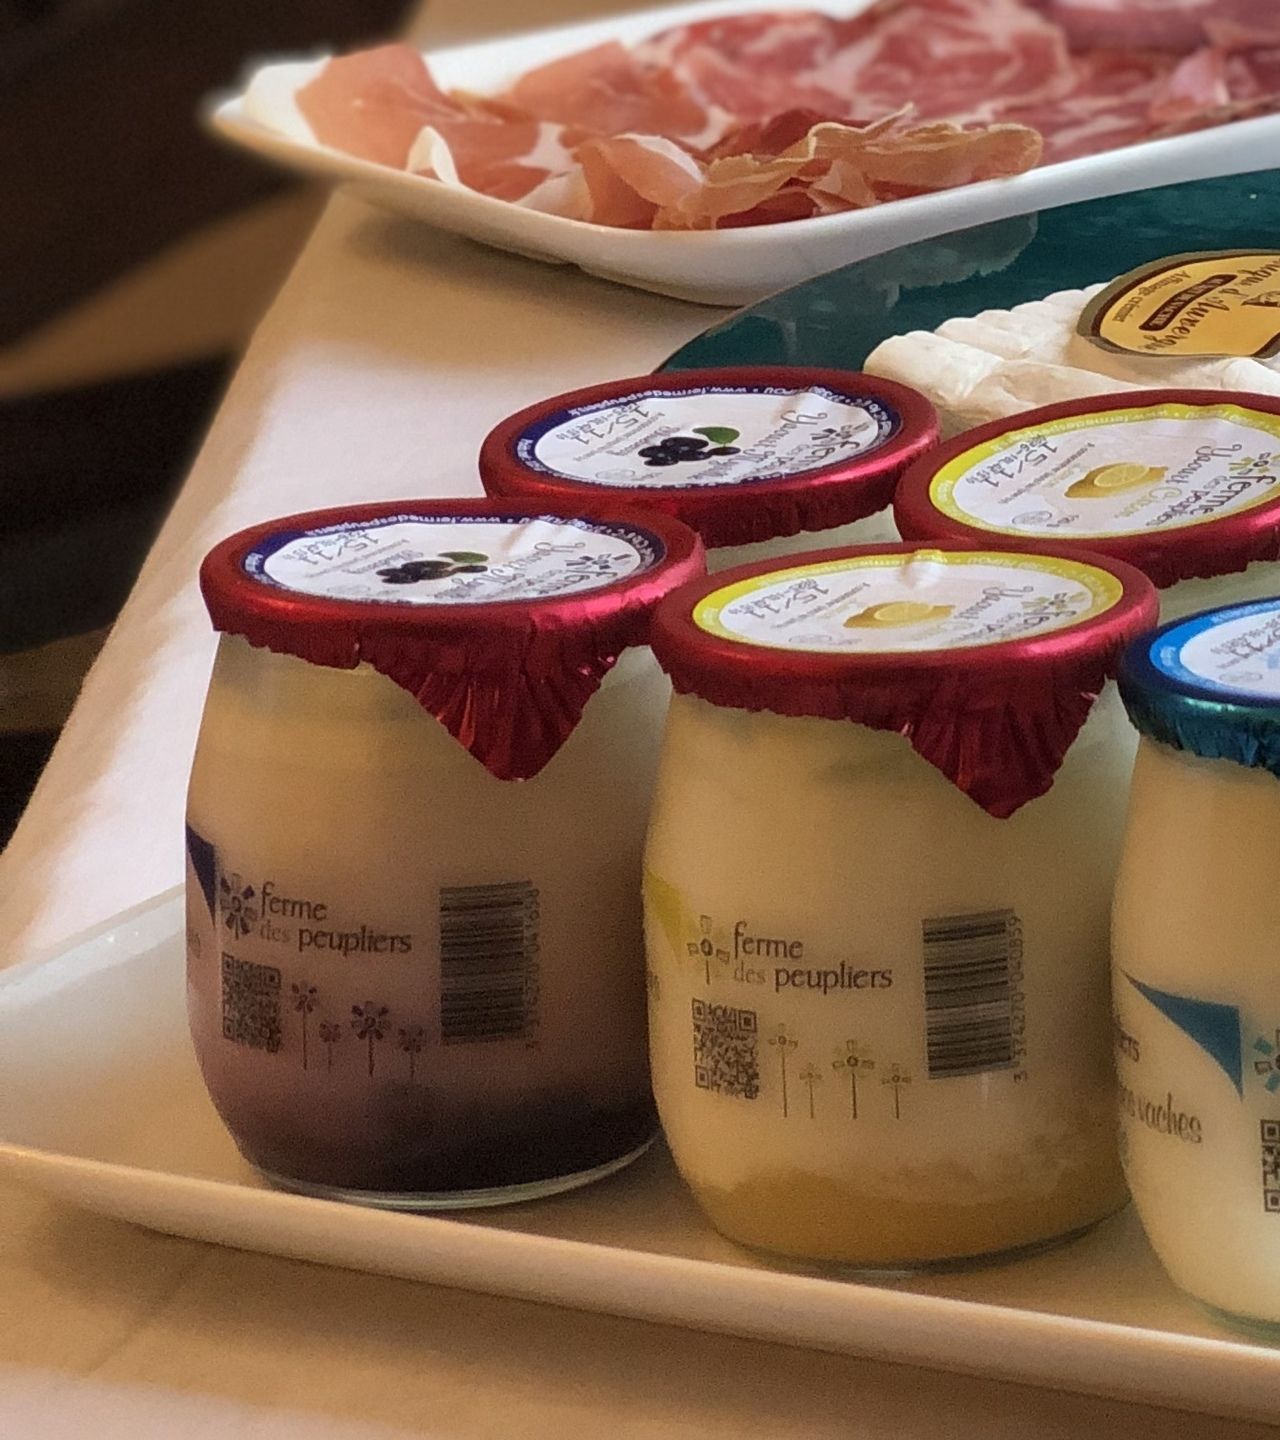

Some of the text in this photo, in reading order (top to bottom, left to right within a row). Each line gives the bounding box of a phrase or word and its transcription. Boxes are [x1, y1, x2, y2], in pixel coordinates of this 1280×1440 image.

[574, 407, 648, 445] 15/11
[753, 411, 827, 448] Yaourt
[985, 442, 1057, 487] 15/11
[1166, 446, 1242, 484] Yaourt
[1190, 476, 1276, 515] ferme
[299, 535, 378, 565] 15/11
[744, 585, 829, 619] 15/11
[954, 586, 1033, 620] Yaourt
[261, 882, 327, 921] ferme
[260, 920, 412, 958] des peupliers
[734, 921, 803, 959] ferme
[734, 961, 893, 994] des peupliers
[1138, 1092, 1202, 1144] vaches
